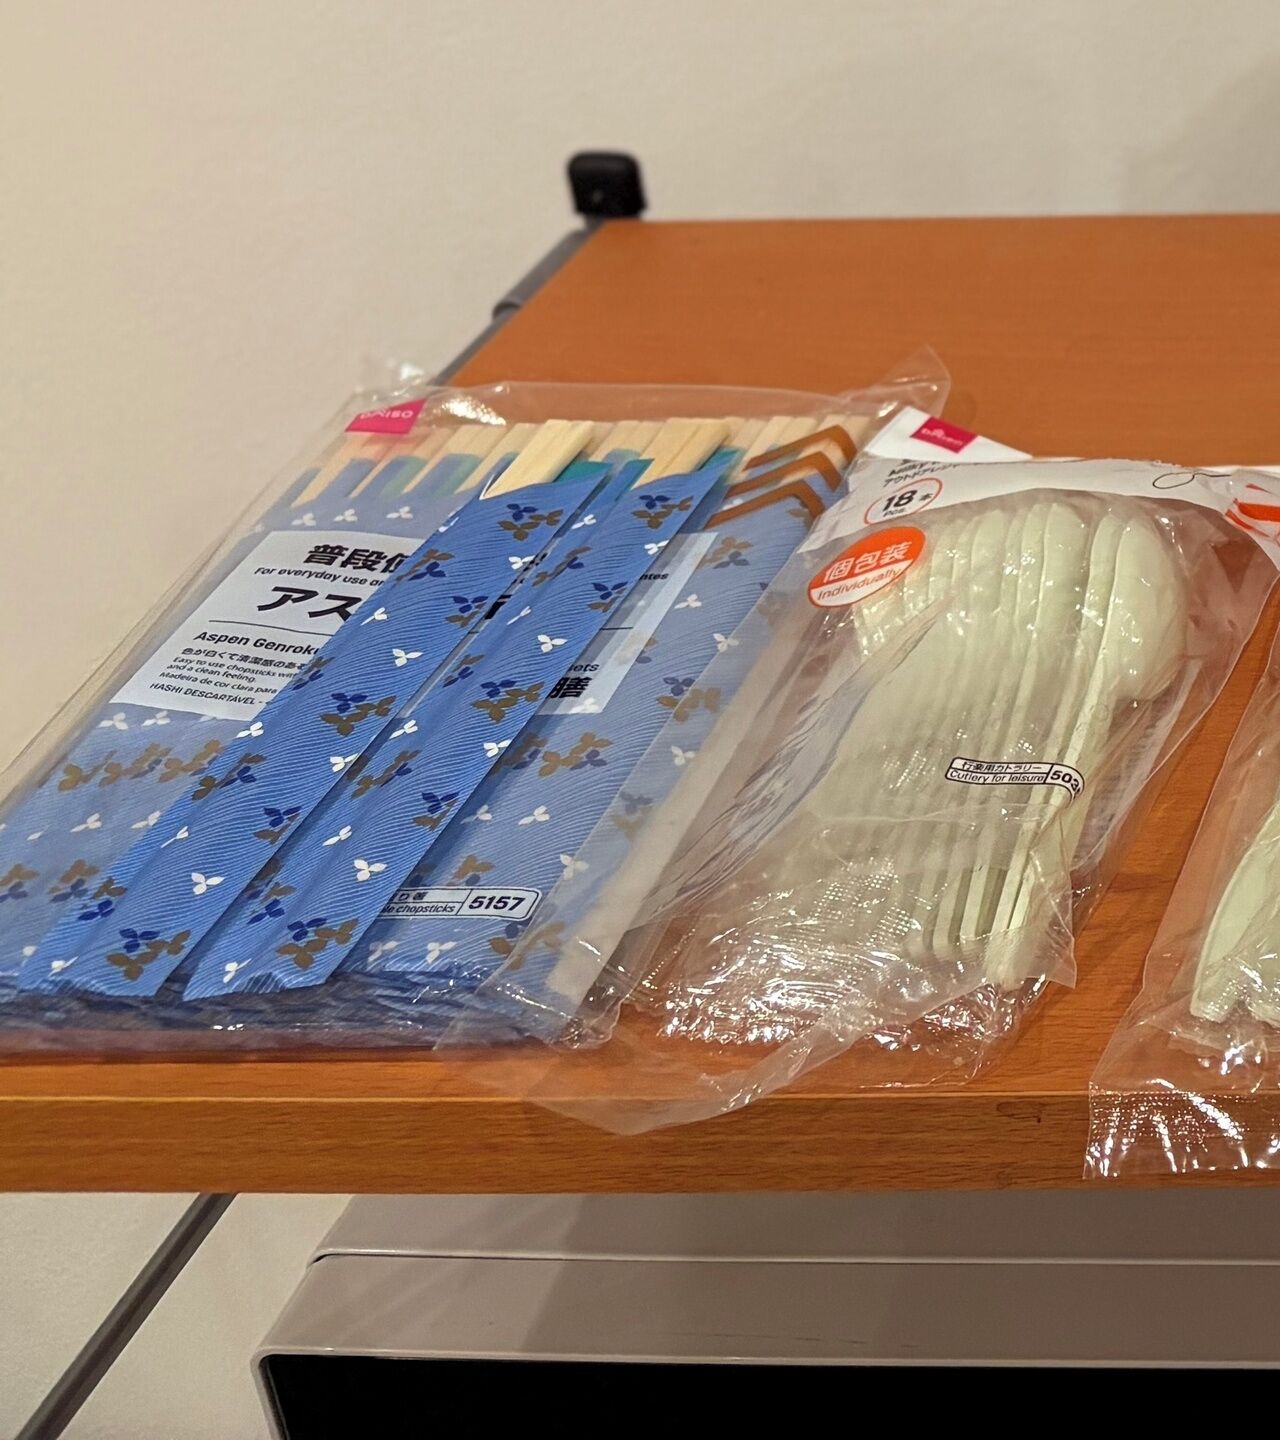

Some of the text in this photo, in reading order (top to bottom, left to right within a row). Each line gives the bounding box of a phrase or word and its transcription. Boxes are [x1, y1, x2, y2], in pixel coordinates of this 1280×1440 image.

[882, 489, 918, 512] 18
[823, 541, 912, 584] 個包装
[254, 566, 368, 586] For everyday use
[816, 568, 901, 601] Individually
[193, 631, 250, 646] Aspen
[167, 663, 188, 672] and
[195, 666, 221, 677] clean
[222, 670, 257, 683] feeling.
[172, 656, 195, 667] Easy
[208, 661, 226, 670] use
[226, 663, 276, 677] chopsticks
[159, 671, 278, 694] Madeira de cor clara para
[149, 682, 256, 706] HASHI DESCARTÁVEL
[949, 769, 1045, 784] Cutlery for leisure
[397, 903, 456, 914] chopsticks
[468, 895, 525, 911] 5157
